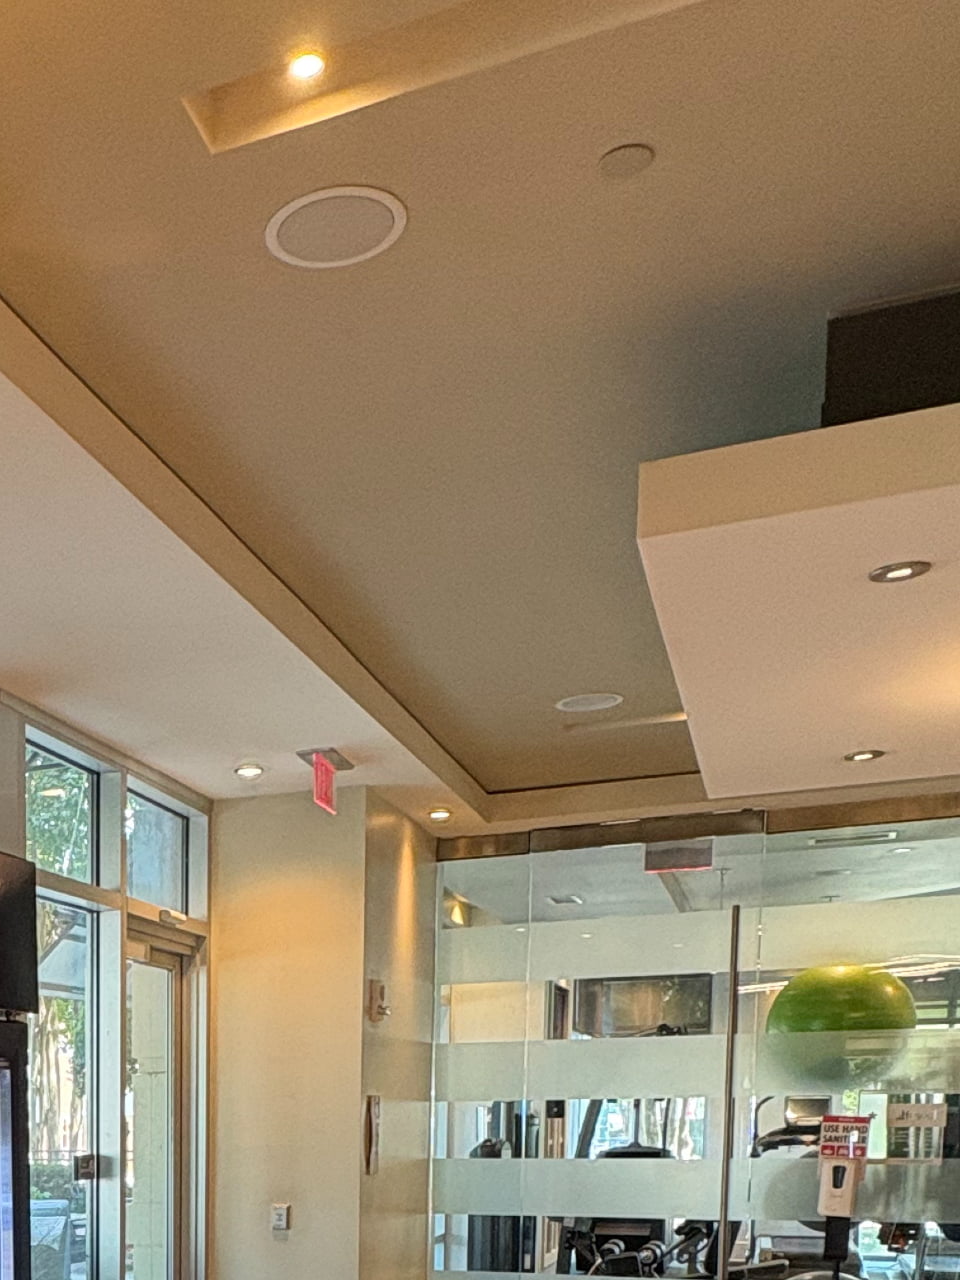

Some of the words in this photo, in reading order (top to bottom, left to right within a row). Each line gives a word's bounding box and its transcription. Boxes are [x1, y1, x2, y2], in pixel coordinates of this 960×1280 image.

[823, 1124, 840, 1133] USE
[842, 1125, 868, 1134] HAND
[823, 1134, 867, 1143] SANITER
